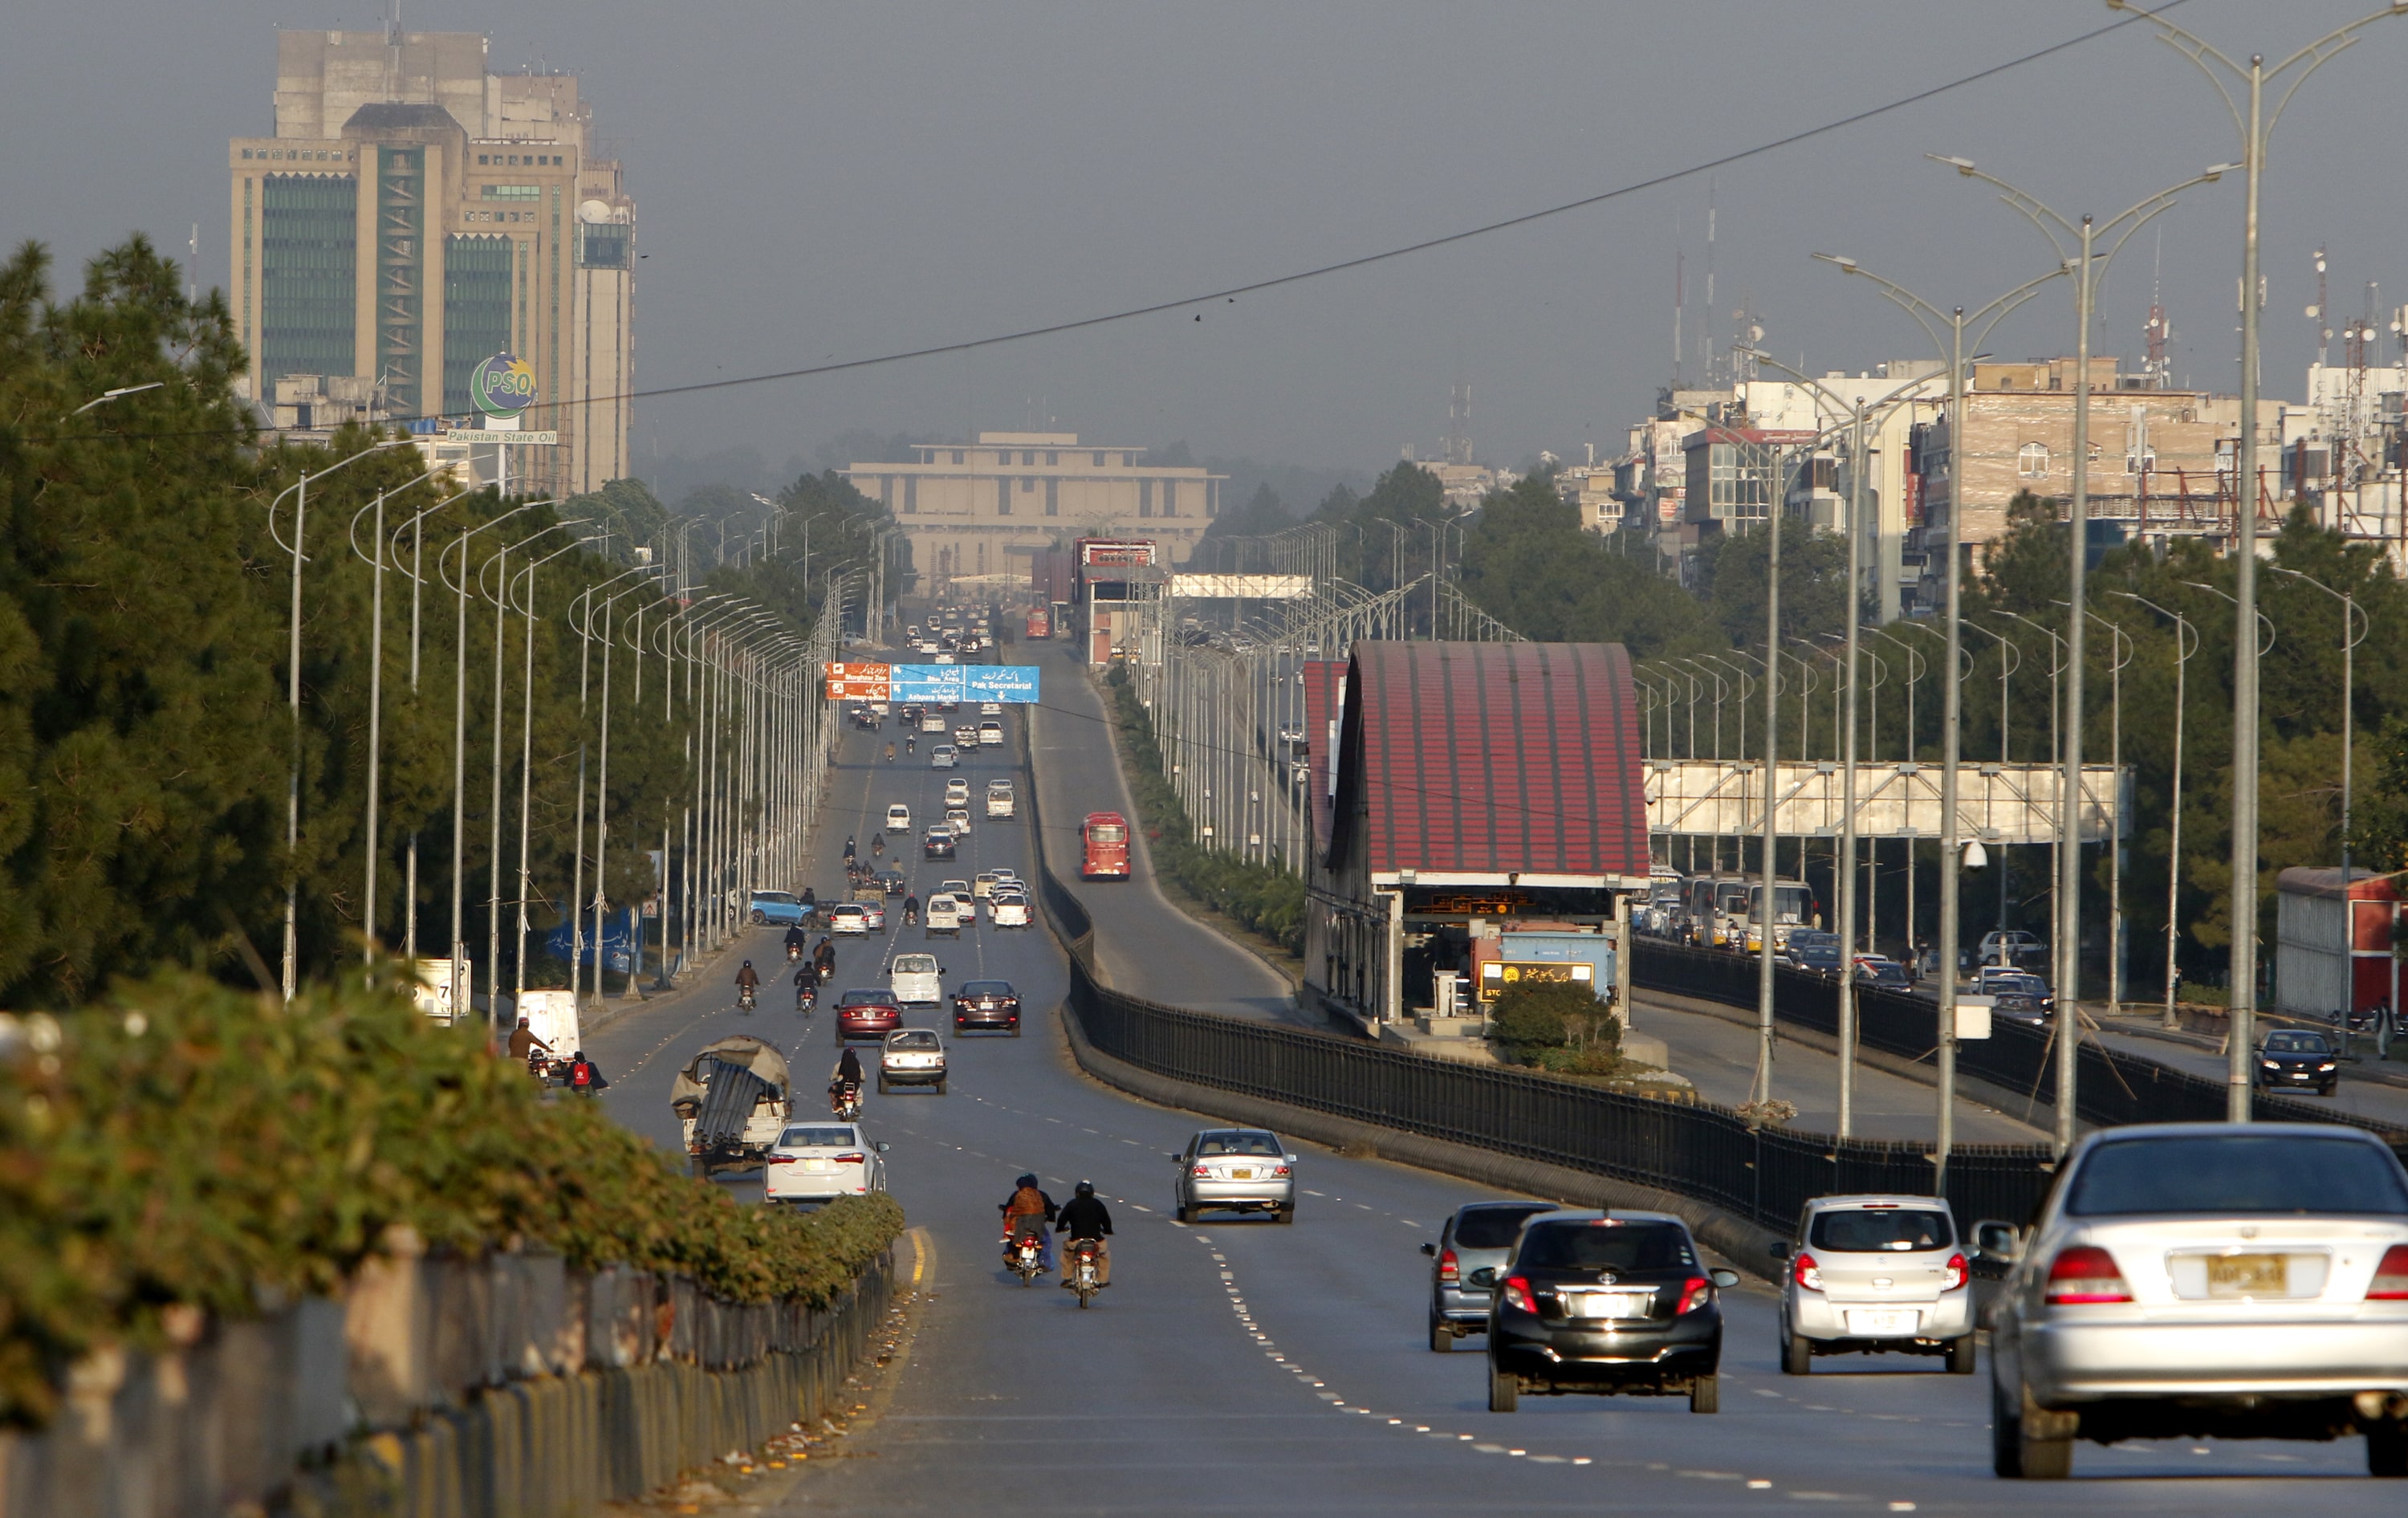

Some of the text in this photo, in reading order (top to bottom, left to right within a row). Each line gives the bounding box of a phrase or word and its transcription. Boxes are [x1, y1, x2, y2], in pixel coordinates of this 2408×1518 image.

[486, 371, 531, 394] PSO
[449, 431, 555, 442] Pakistan State Oil
[971, 681, 1032, 690] Pak Secretariat
[1486, 989, 1502, 997] STO
